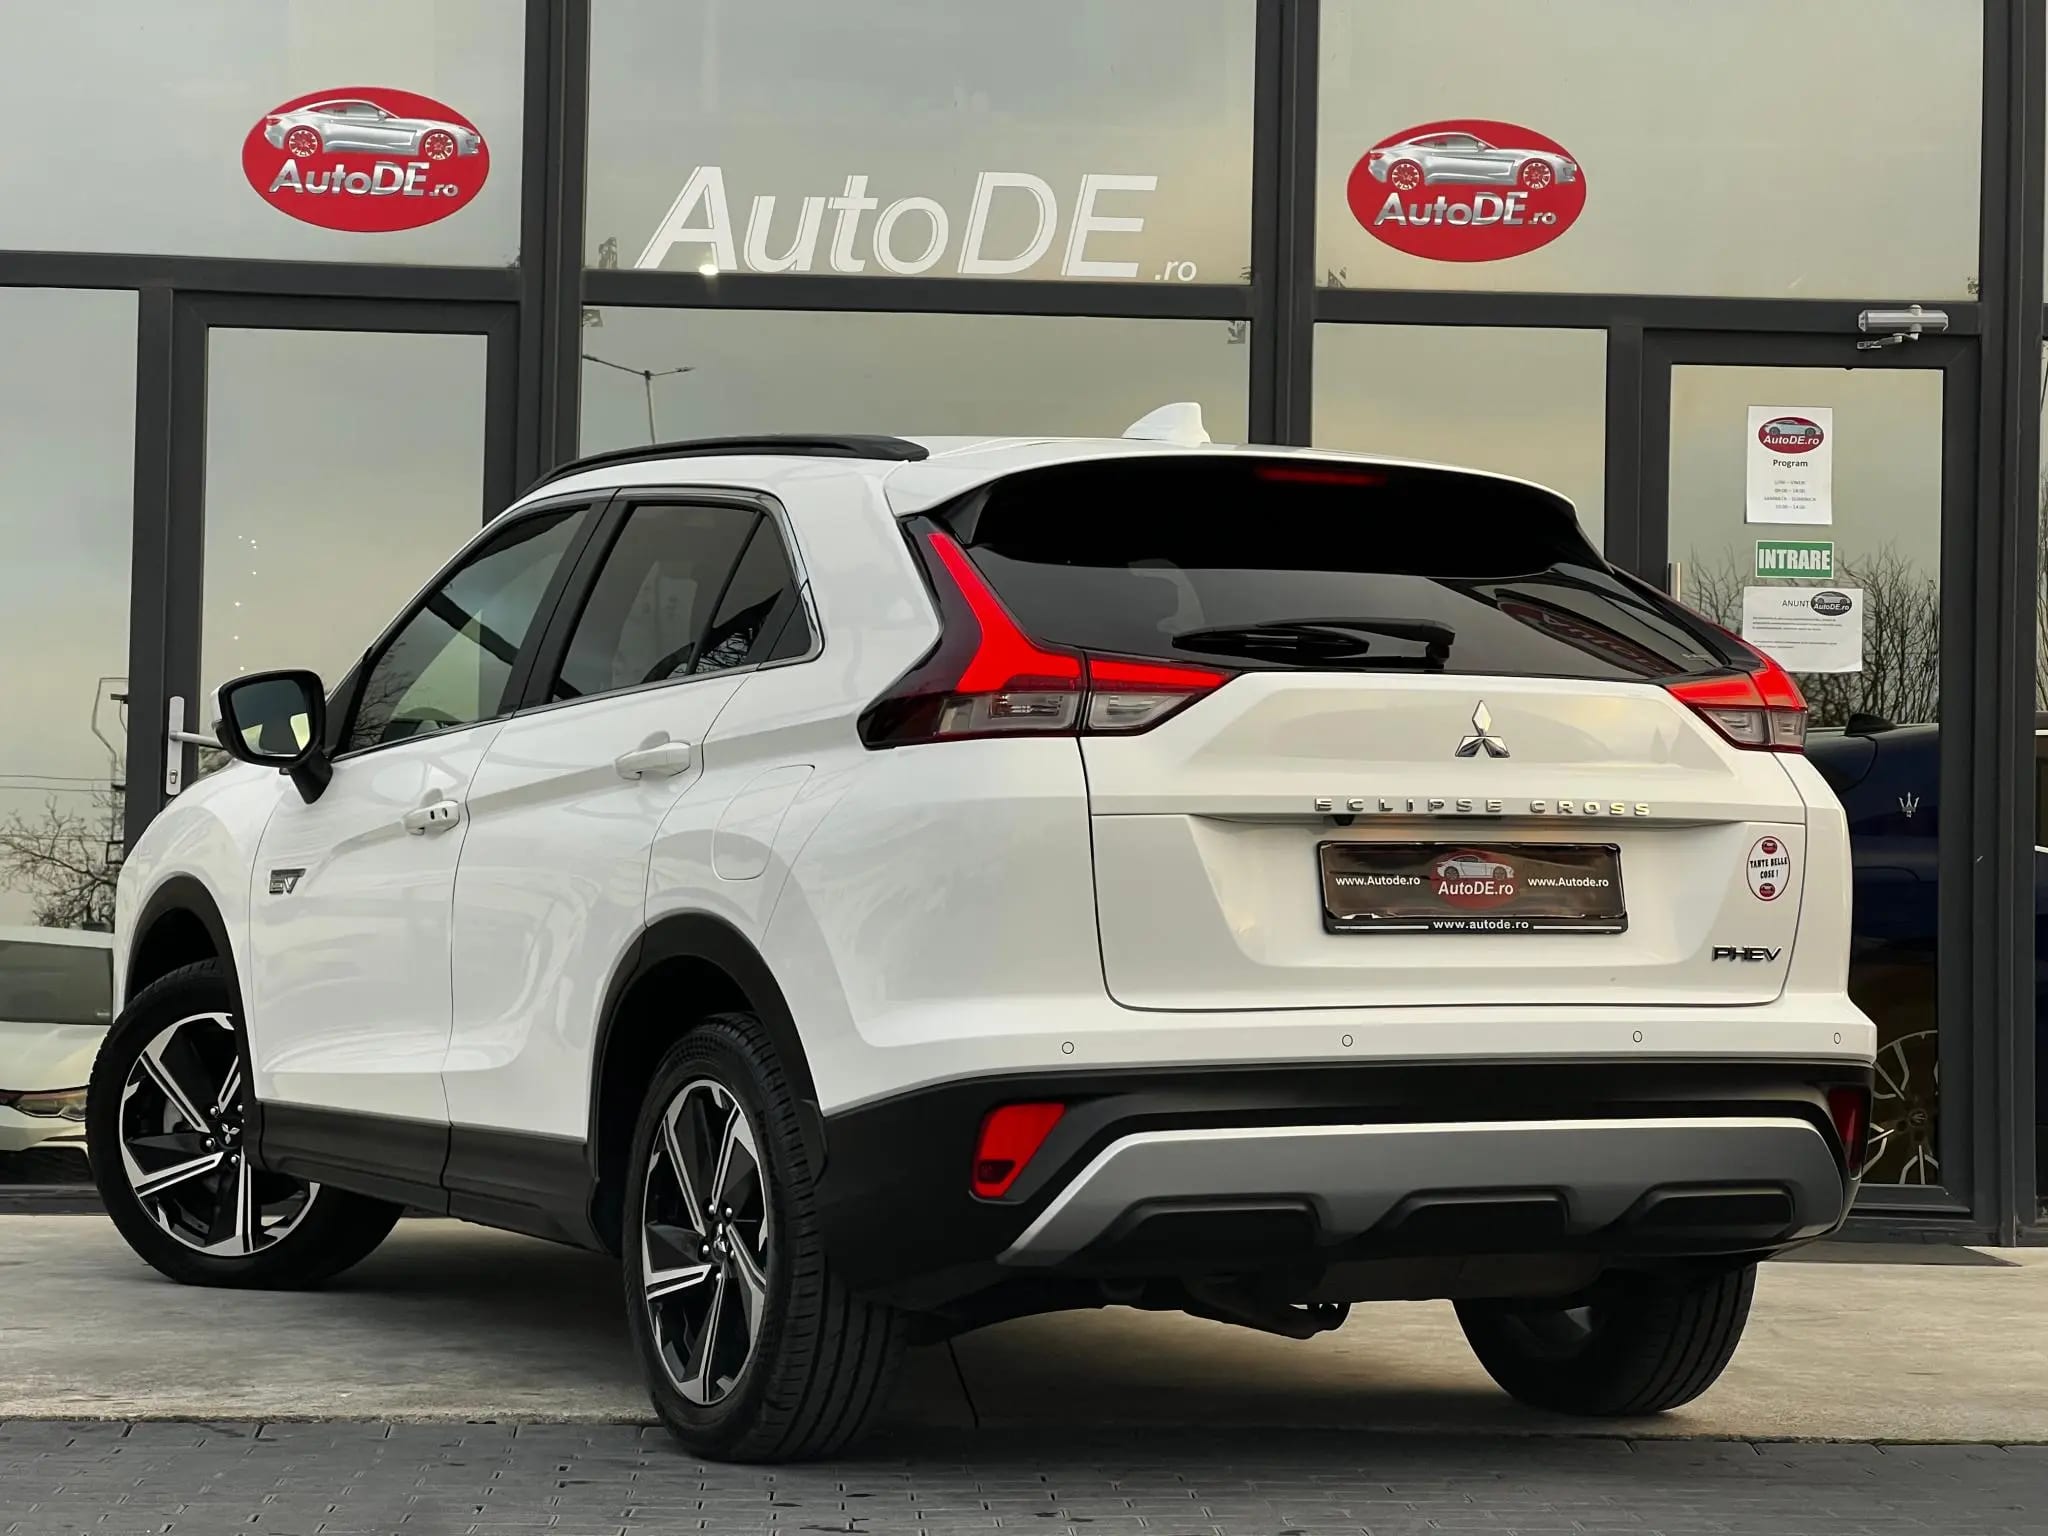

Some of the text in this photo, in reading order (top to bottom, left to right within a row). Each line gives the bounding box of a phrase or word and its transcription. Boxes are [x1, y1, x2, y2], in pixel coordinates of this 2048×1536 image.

[1763, 434, 1820, 446] AutoDE.ro
[1772, 459, 1808, 468] Program
[1758, 548, 1831, 570] INTRARE
[1314, 798, 1651, 816] ECLIPSE CROSS
[1750, 857, 1788, 868] TANTE BELLE
[1335, 875, 1421, 886] www.Autode.ro
[1760, 870, 1775, 879] COSE
[1527, 875, 1609, 888] www.Autode.ro
[1438, 880, 1514, 896] AutoDE.ro
[1433, 919, 1529, 930] www.autode.ro
[1711, 945, 1782, 961] PHEV
